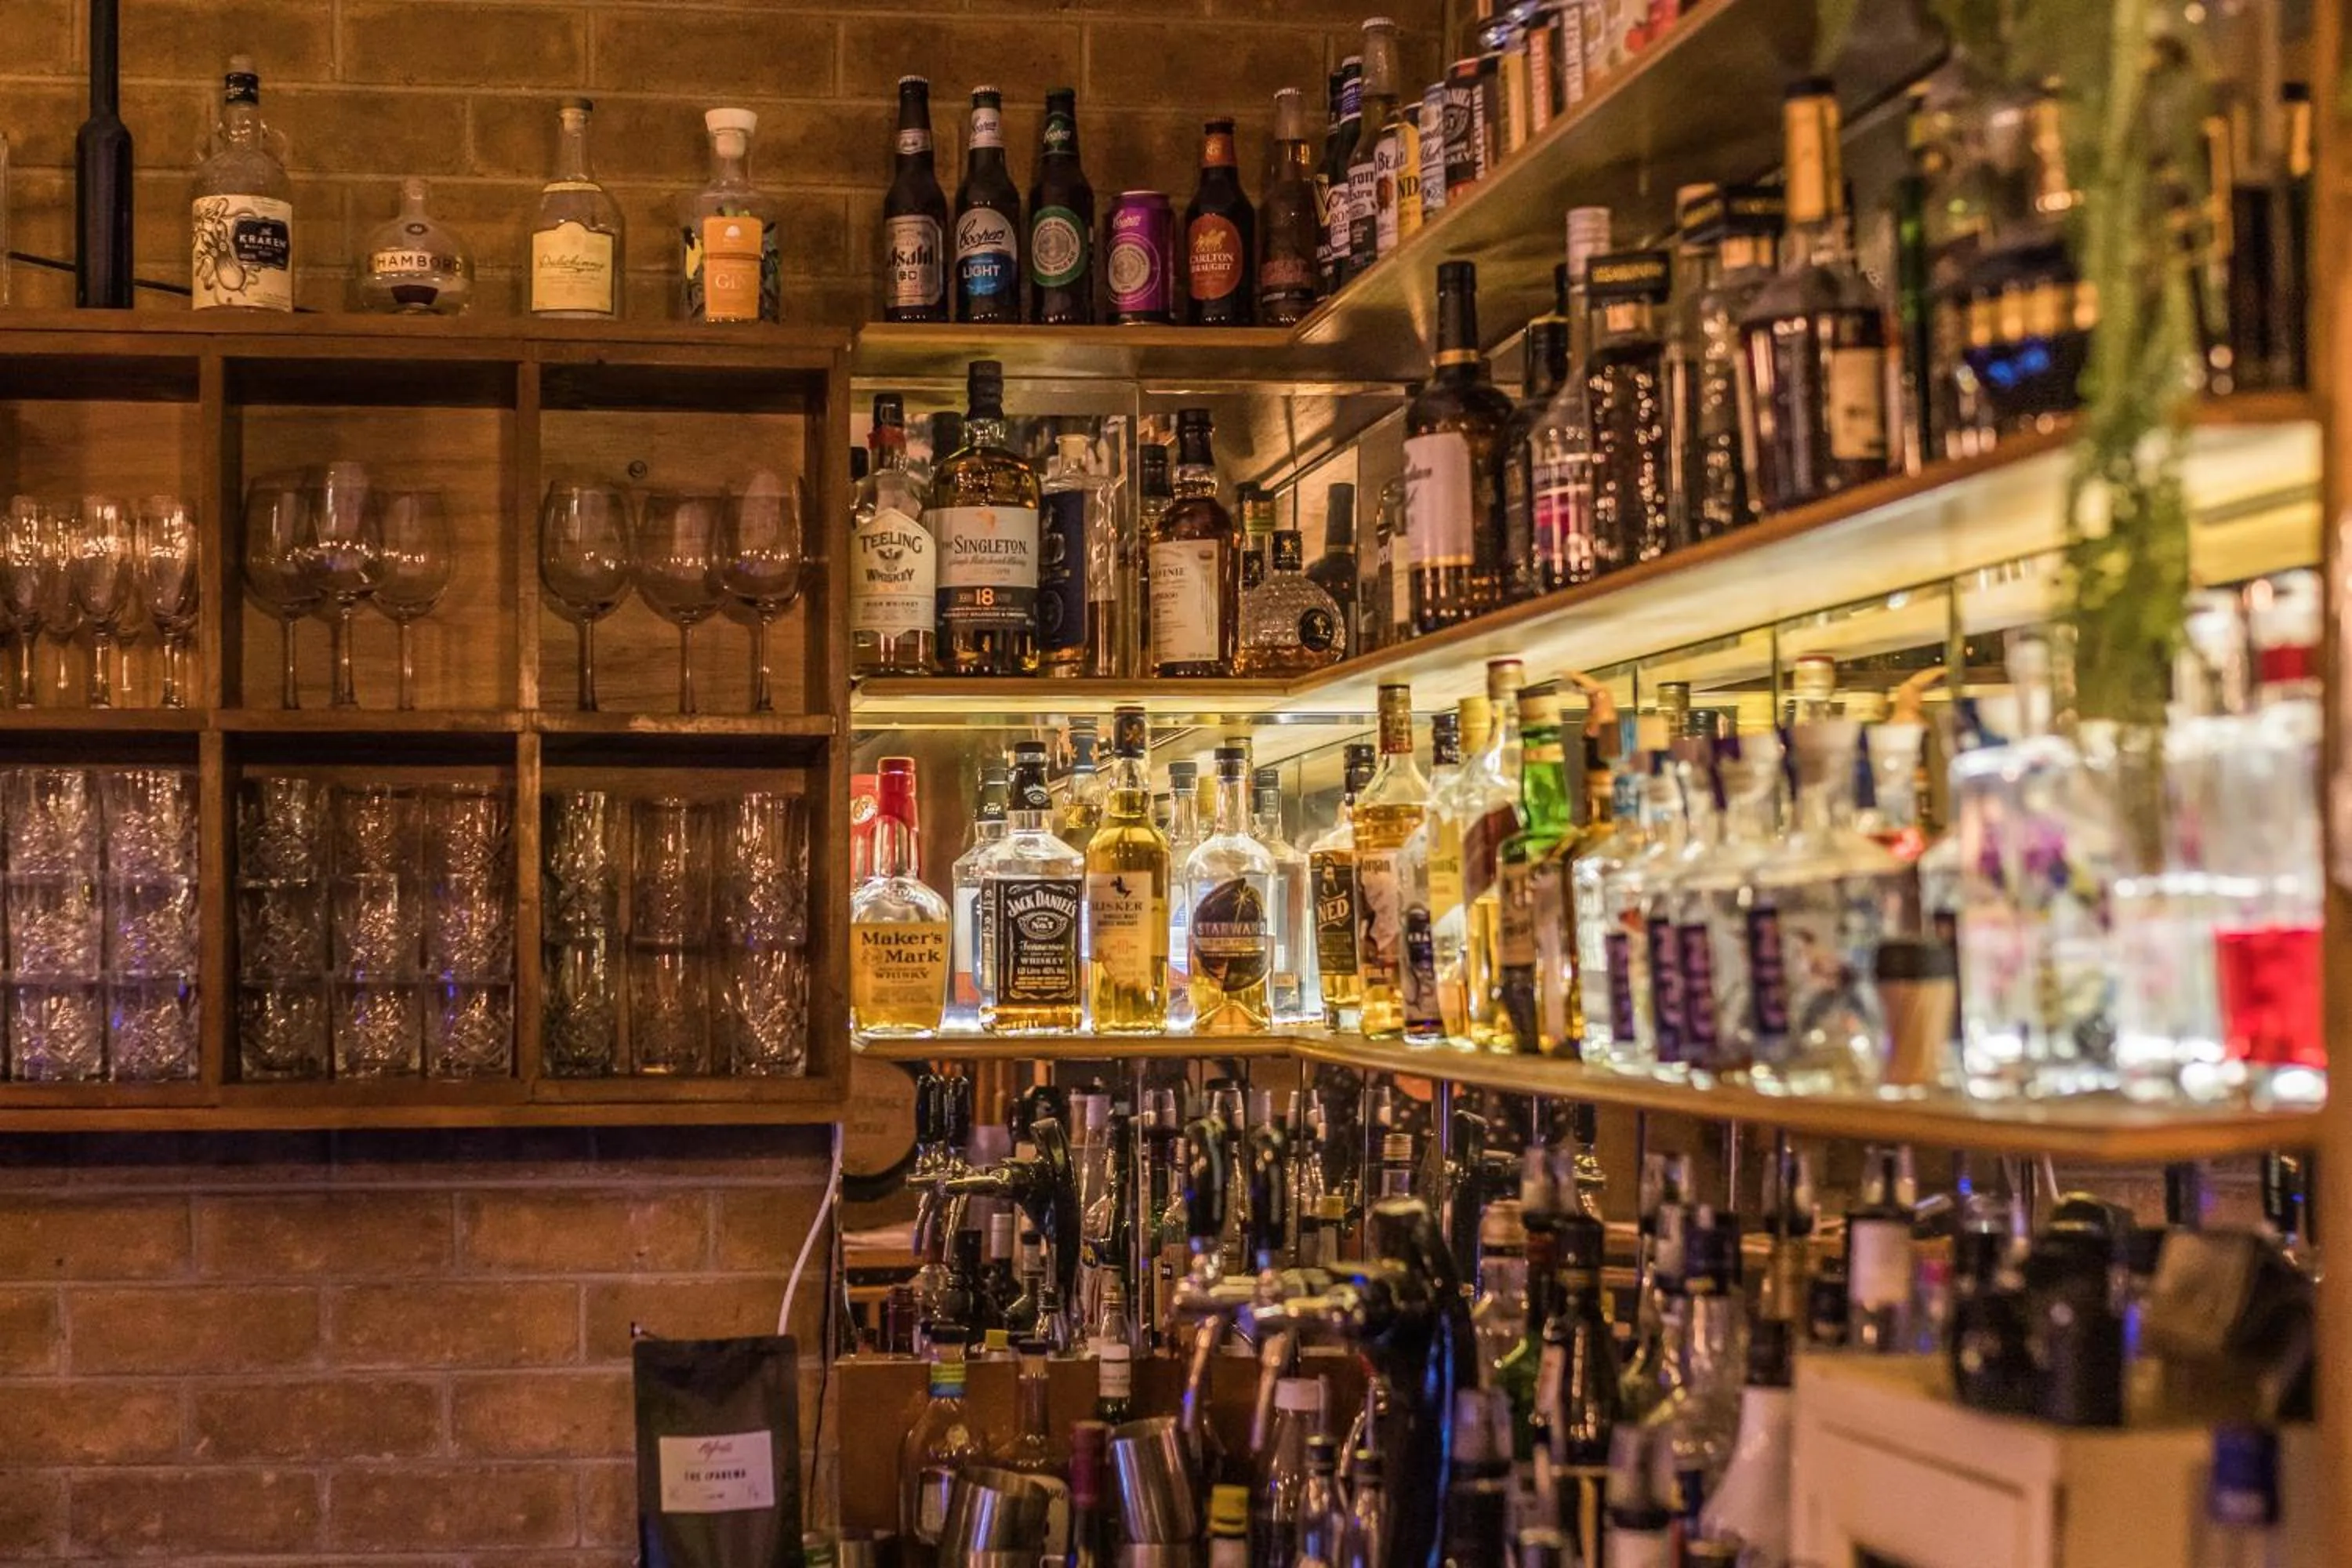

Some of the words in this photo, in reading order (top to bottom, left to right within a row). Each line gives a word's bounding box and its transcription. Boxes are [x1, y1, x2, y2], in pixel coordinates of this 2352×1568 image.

[238, 234, 288, 249] KRAKEN
[964, 264, 1002, 279] LIGHT
[858, 531, 924, 554] TEELING
[954, 535, 1027, 554] SINGLETON
[865, 568, 916, 583] WHISKEY
[975, 586, 995, 606] 18
[1007, 895, 1034, 918] JACK
[1035, 890, 1078, 916] DANIEL'S
[1317, 898, 1349, 924] NED
[1196, 922, 1266, 935] STARWARD
[862, 931, 943, 946] Maker's
[884, 949, 942, 963] Mark
